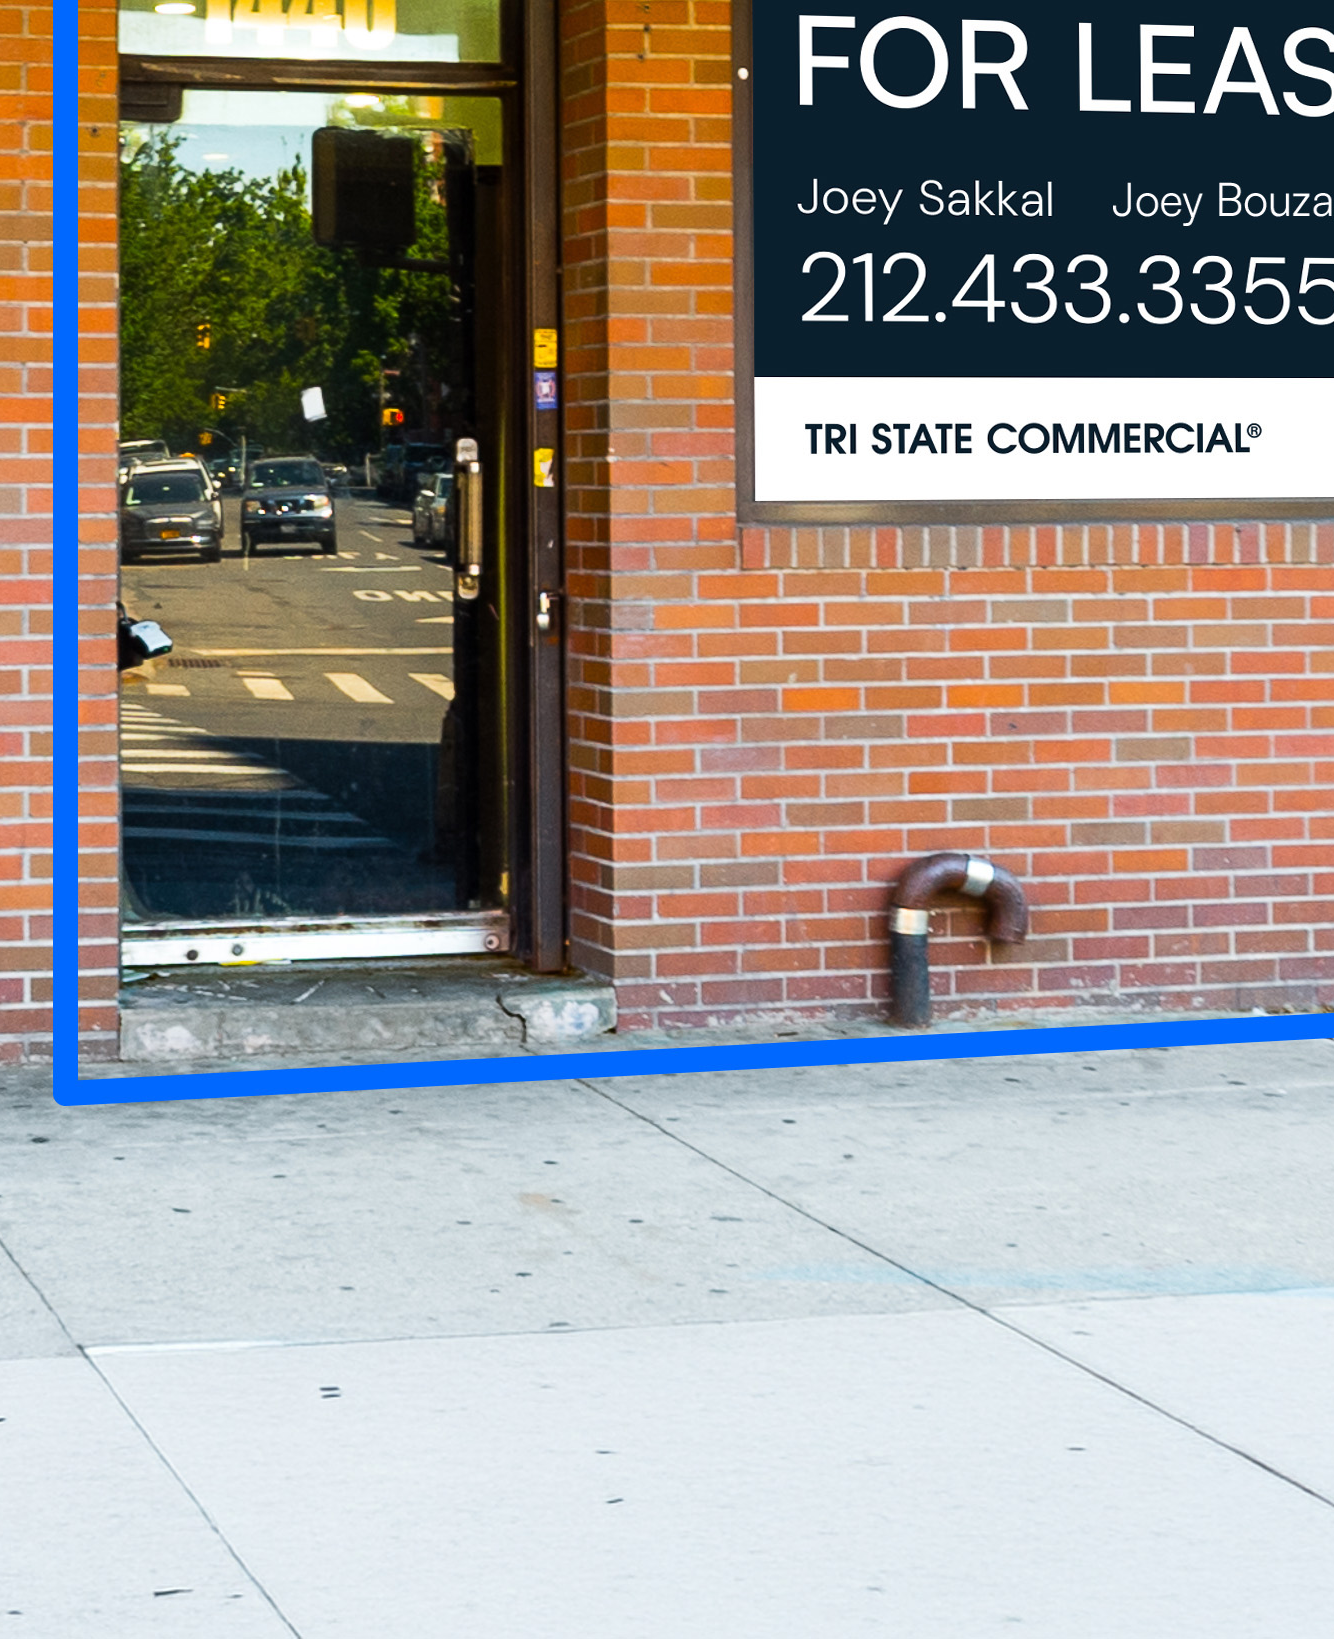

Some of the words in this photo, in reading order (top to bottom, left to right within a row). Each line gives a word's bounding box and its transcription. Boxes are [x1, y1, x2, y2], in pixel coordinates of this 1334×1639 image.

[798, 14, 1029, 111] FOR
[797, 178, 903, 226] Joey
[919, 180, 1053, 218] Sakkal
[1113, 183, 1204, 227] Joey
[805, 424, 857, 455] TRI
[871, 423, 972, 455] STATE
